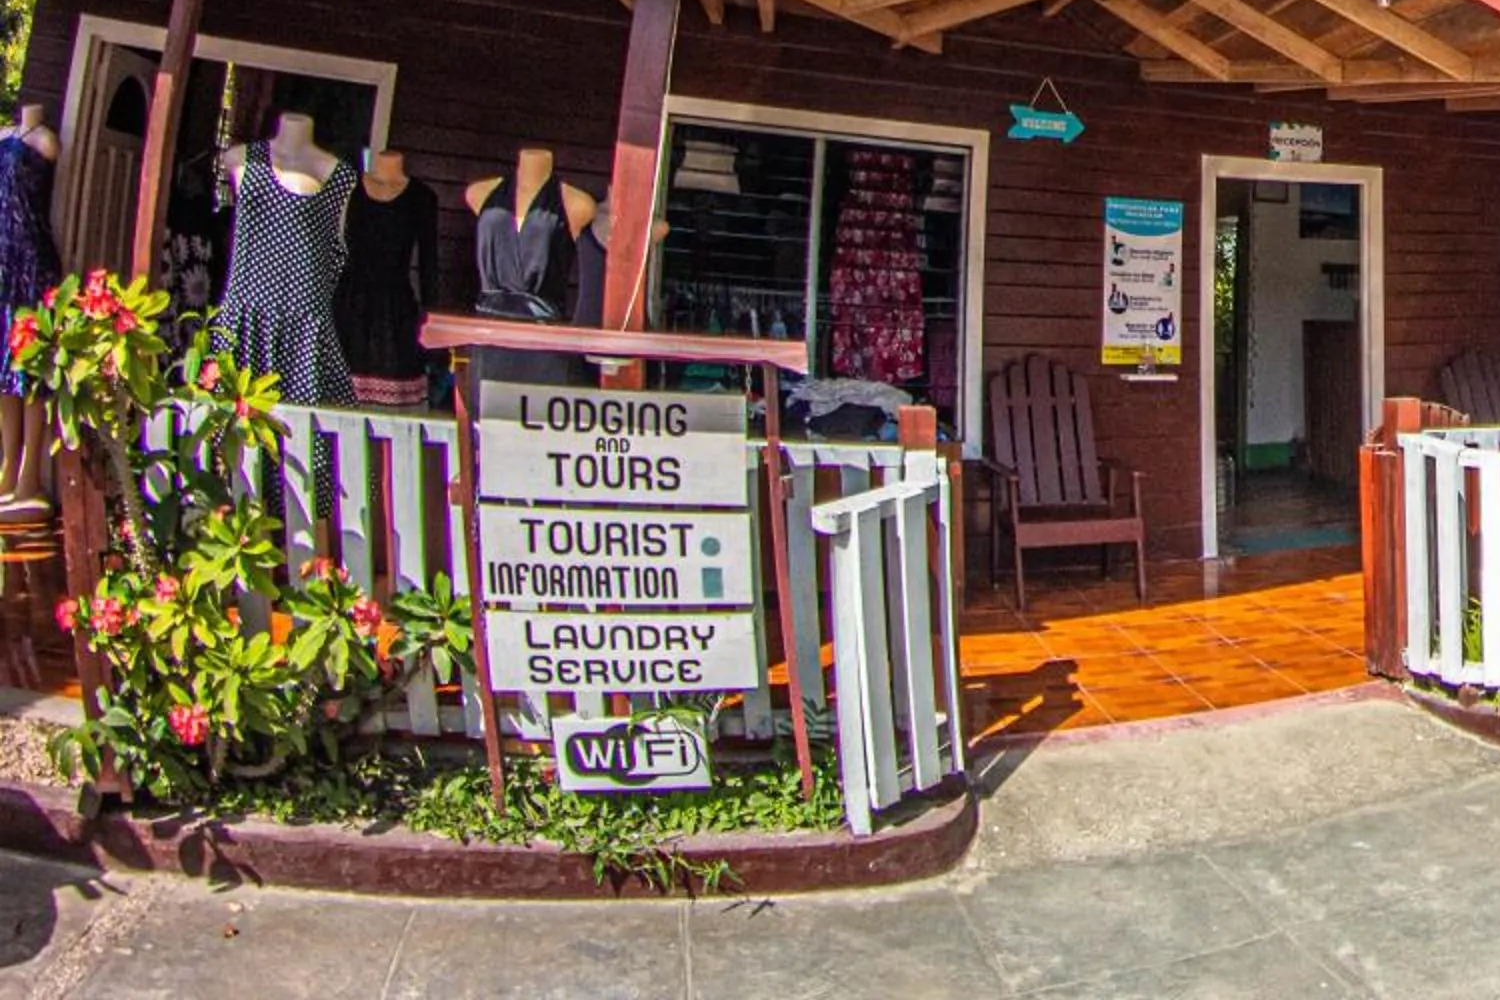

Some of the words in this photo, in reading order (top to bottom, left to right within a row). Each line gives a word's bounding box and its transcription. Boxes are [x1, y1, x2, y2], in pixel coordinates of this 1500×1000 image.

[521, 396, 687, 436] LODGING
[595, 438, 631, 454] AND
[548, 453, 681, 490] TOURS
[520, 519, 693, 557] TOURIST
[489, 561, 678, 598] INFORMATION
[525, 620, 715, 651] LAUNDRY
[530, 657, 702, 684] SERVICE
